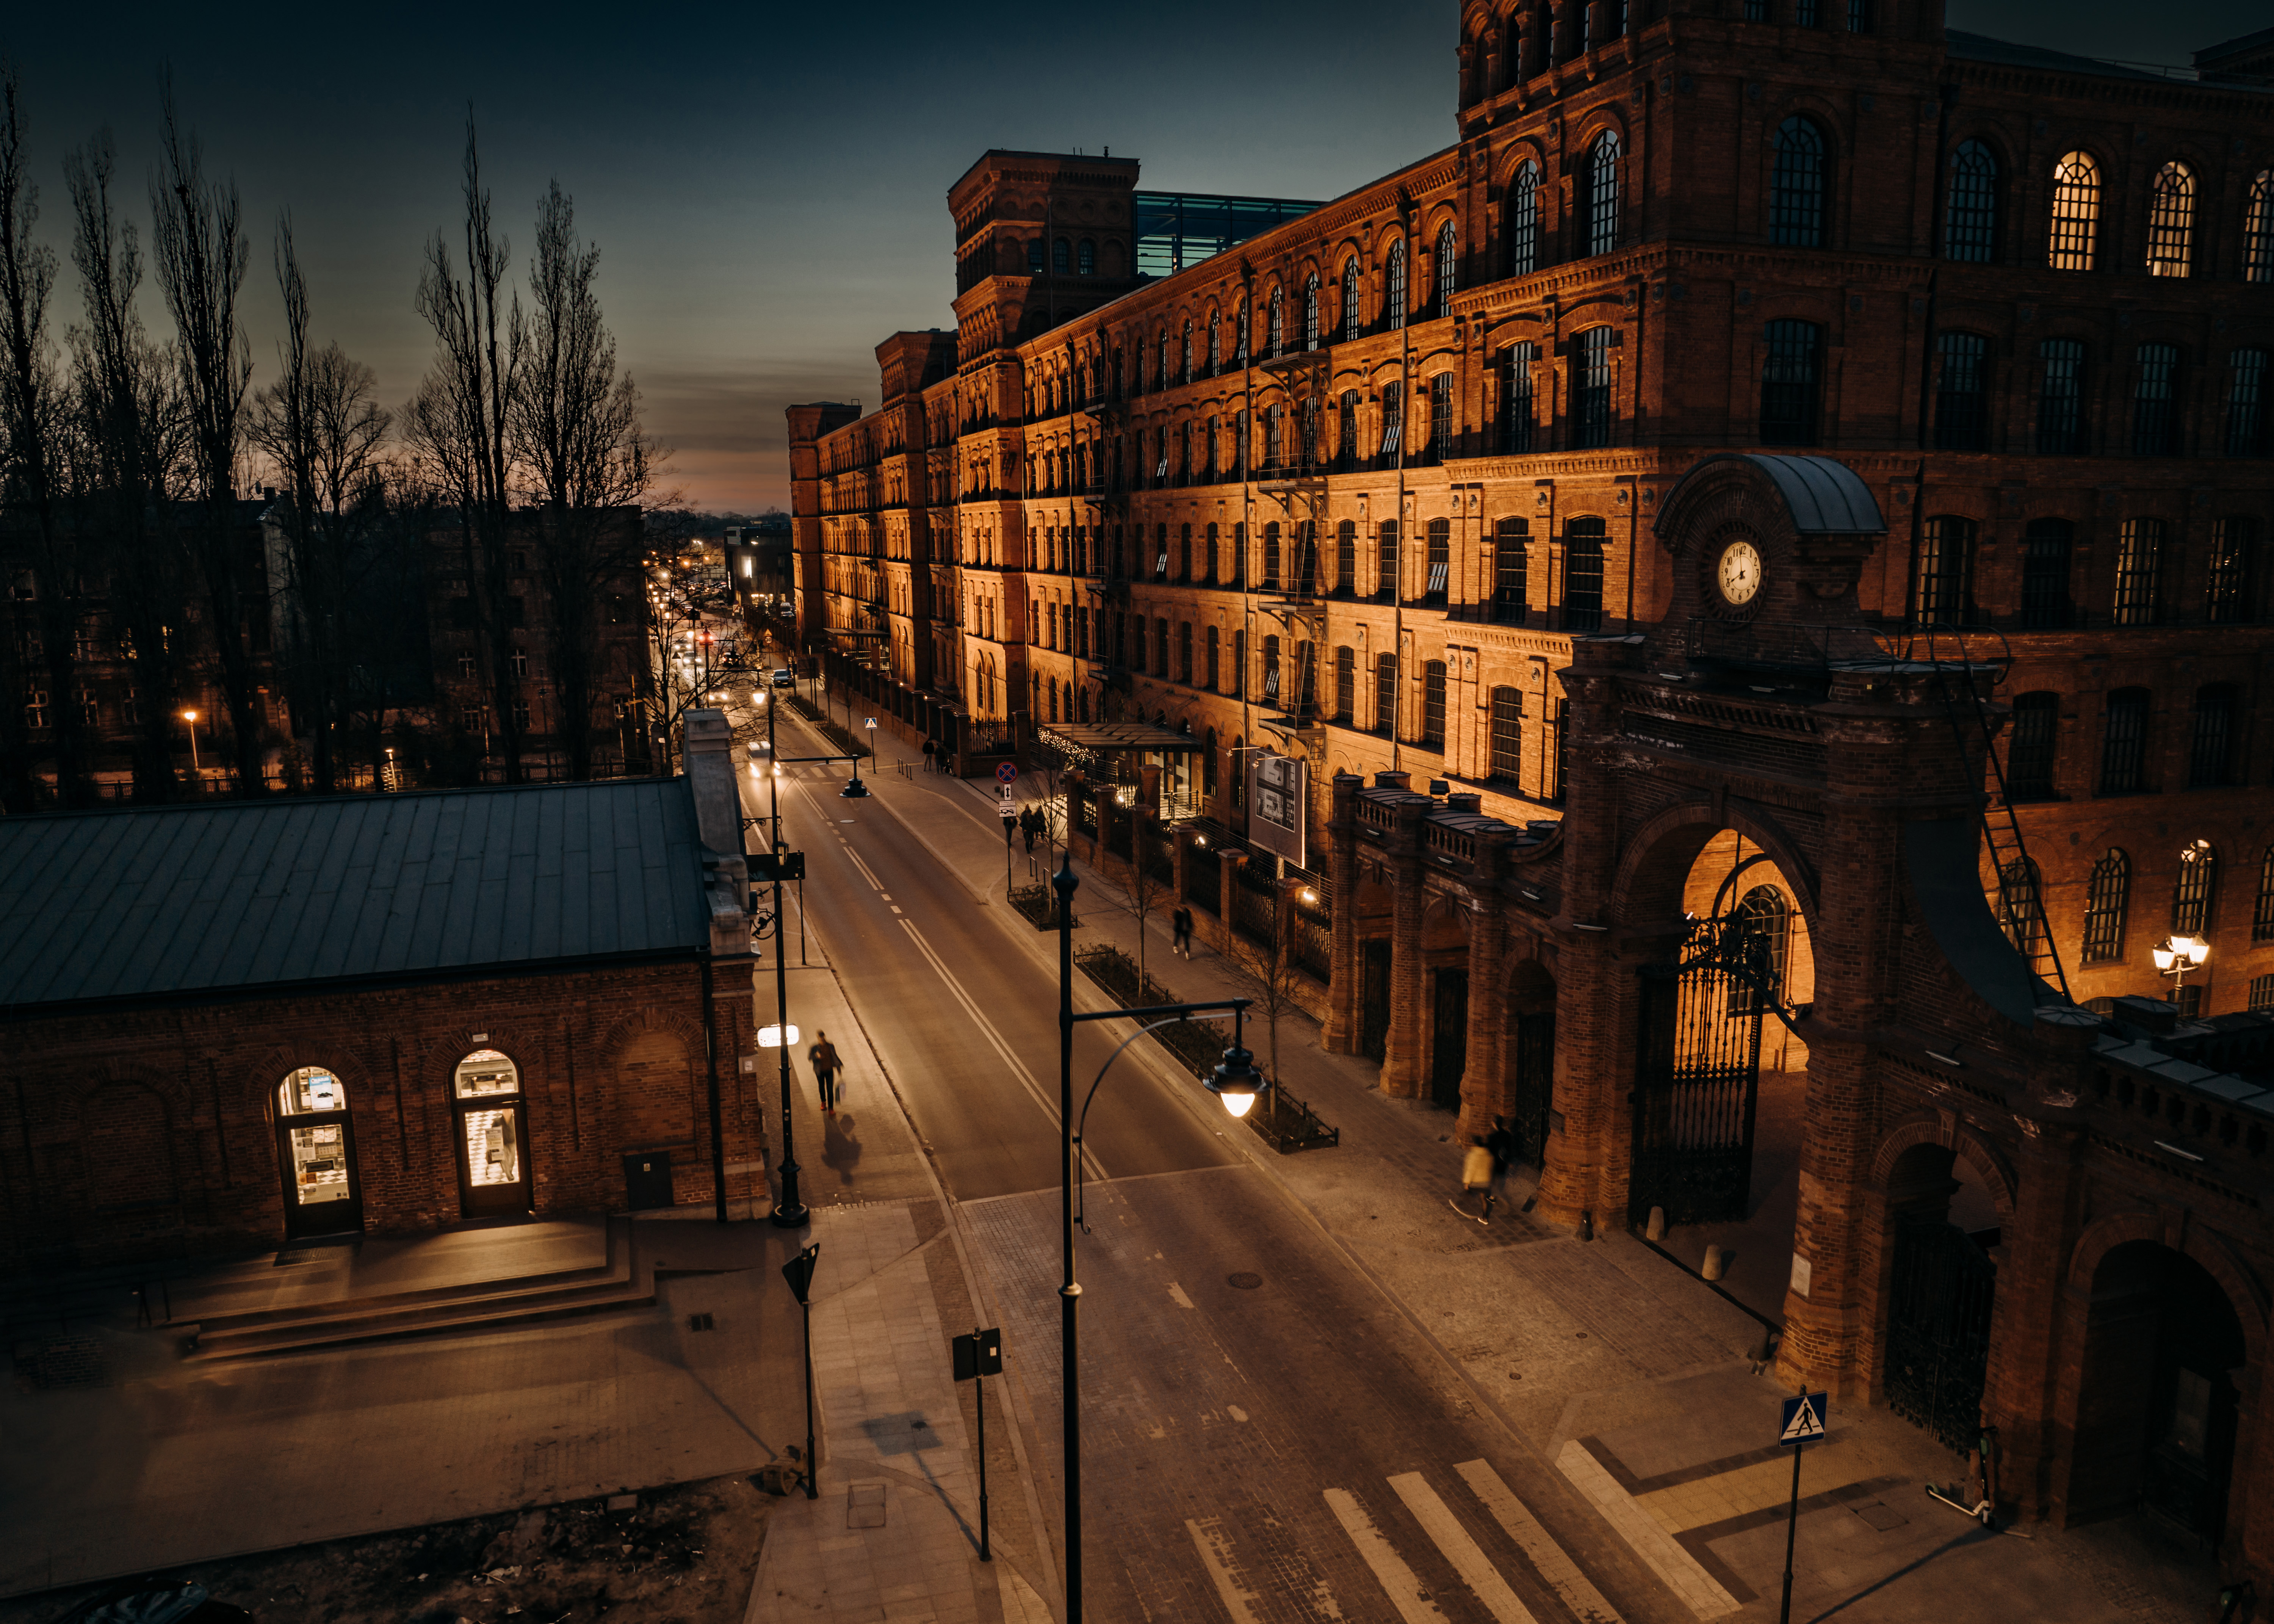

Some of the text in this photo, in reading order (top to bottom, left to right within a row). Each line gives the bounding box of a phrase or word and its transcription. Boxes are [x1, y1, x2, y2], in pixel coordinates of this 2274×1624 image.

[1733, 548, 1738, 557] 11
[1741, 545, 1746, 554] 12
[1750, 549, 1752, 558] 1
[1727, 556, 1732, 565] 10
[1754, 557, 1757, 566] 2
[1725, 568, 1728, 576] 9
[1755, 569, 1759, 578] 3
[1726, 578, 1730, 587] 8
[1752, 580, 1756, 589] 4
[1731, 588, 1734, 597] 7
[1738, 591, 1742, 600] 6
[1746, 589, 1750, 598] 5
